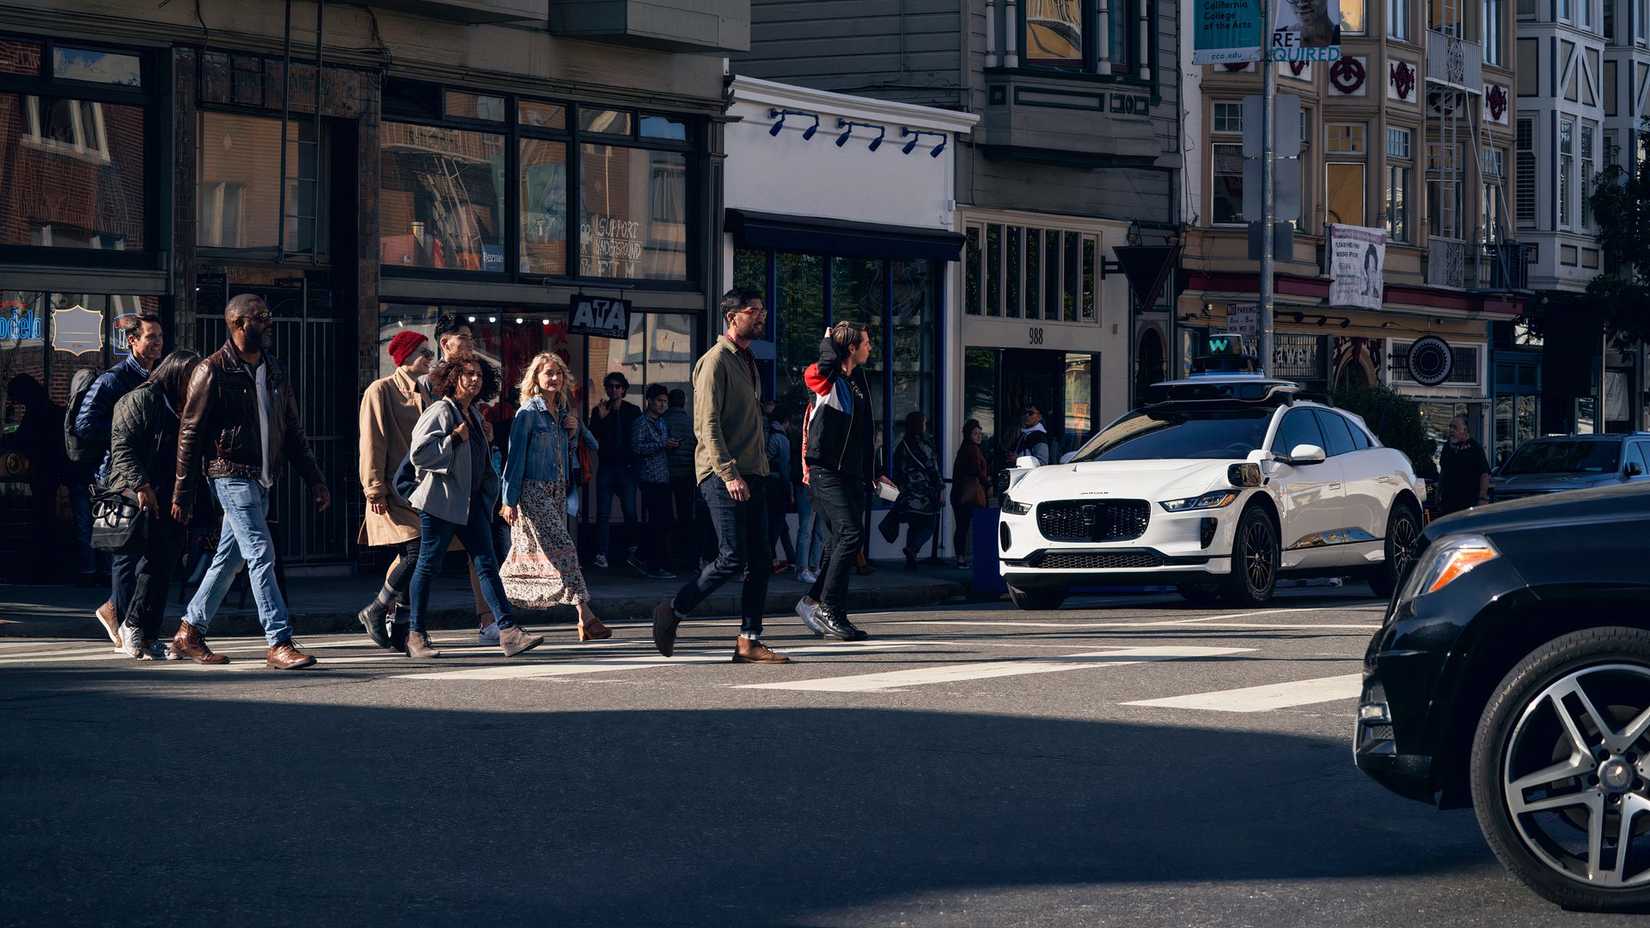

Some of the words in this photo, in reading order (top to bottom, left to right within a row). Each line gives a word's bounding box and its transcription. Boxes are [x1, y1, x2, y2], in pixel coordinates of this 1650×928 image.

[1204, 1, 1248, 10] California
[1204, 11, 1236, 20] College
[1203, 22, 1213, 30] of
[1216, 21, 1230, 29] the
[1233, 20, 1252, 29] Arts
[1273, 33, 1301, 47] RE-
[1272, 47, 1340, 61] QUIRED
[572, 299, 626, 331] ATA
[0, 309, 42, 339] odelo
[1029, 327, 1043, 344] 988
